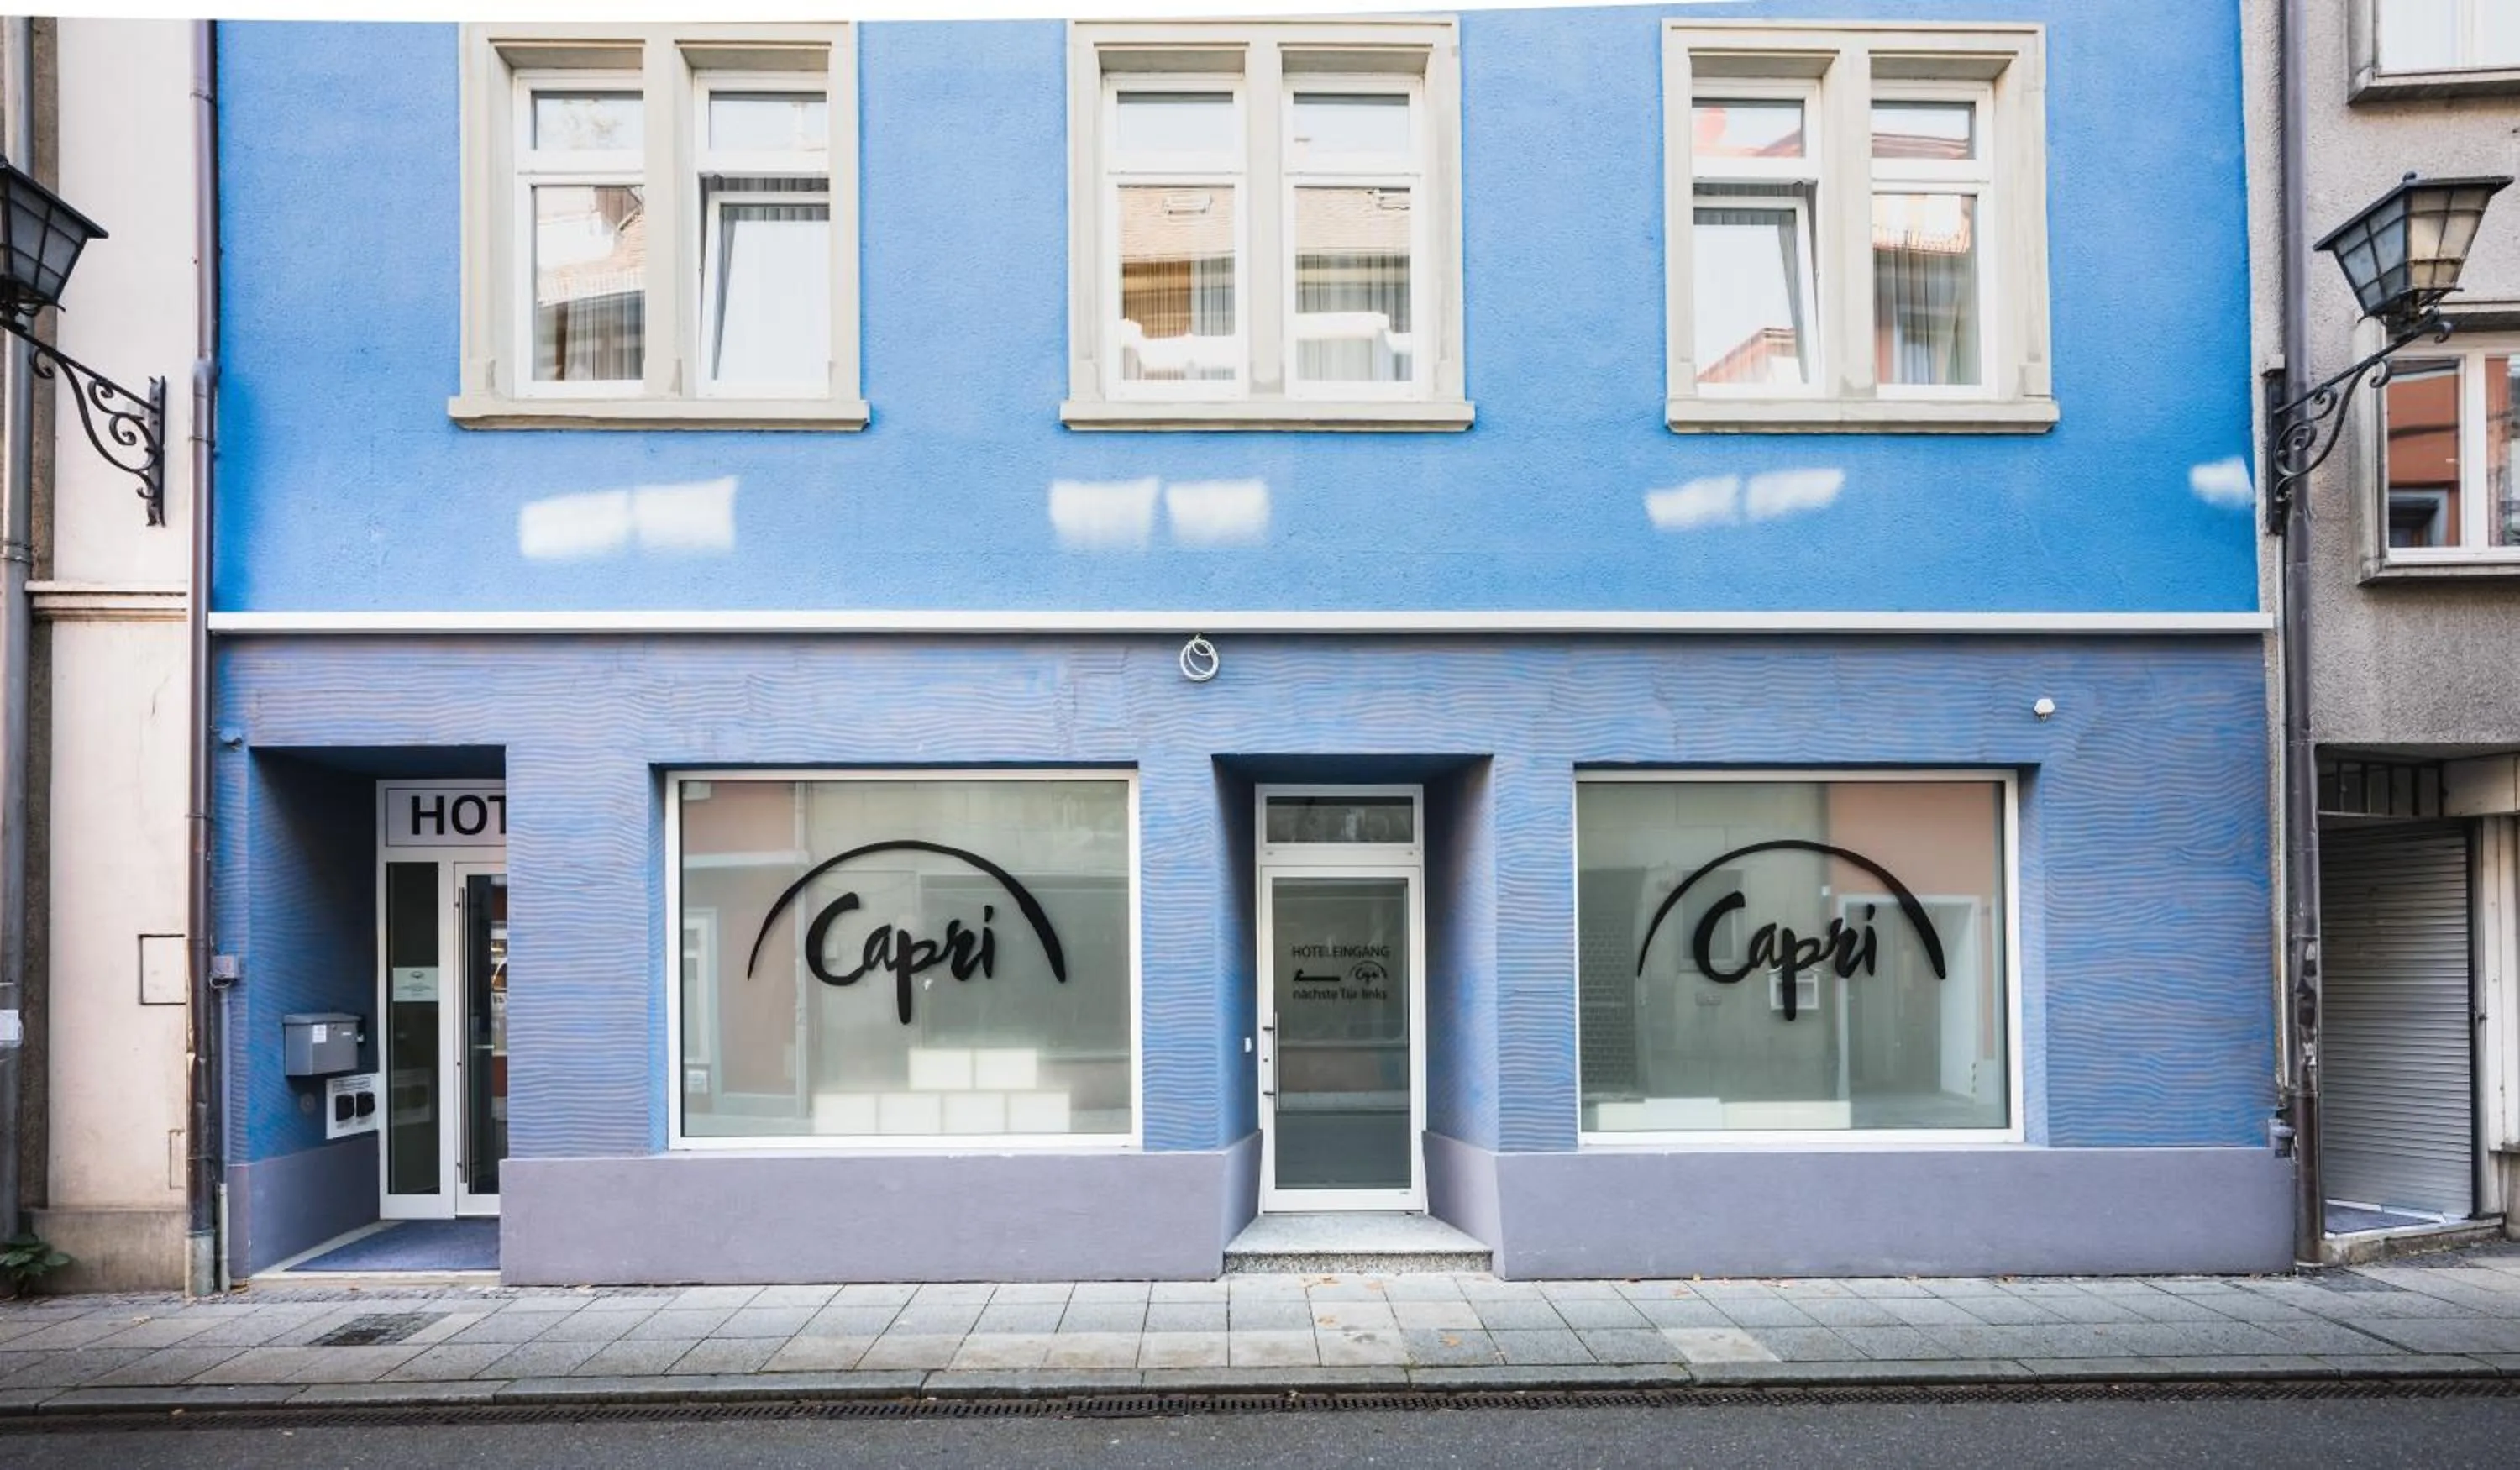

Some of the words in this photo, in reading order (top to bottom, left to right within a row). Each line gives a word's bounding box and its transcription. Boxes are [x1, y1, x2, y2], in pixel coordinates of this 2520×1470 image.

[412, 795, 507, 835] HOT
[806, 891, 995, 1025] Capri
[1292, 946, 1391, 958] HOTELEINGANG
[1693, 890, 1877, 1021] Capri
[1362, 987, 1388, 1000] links
